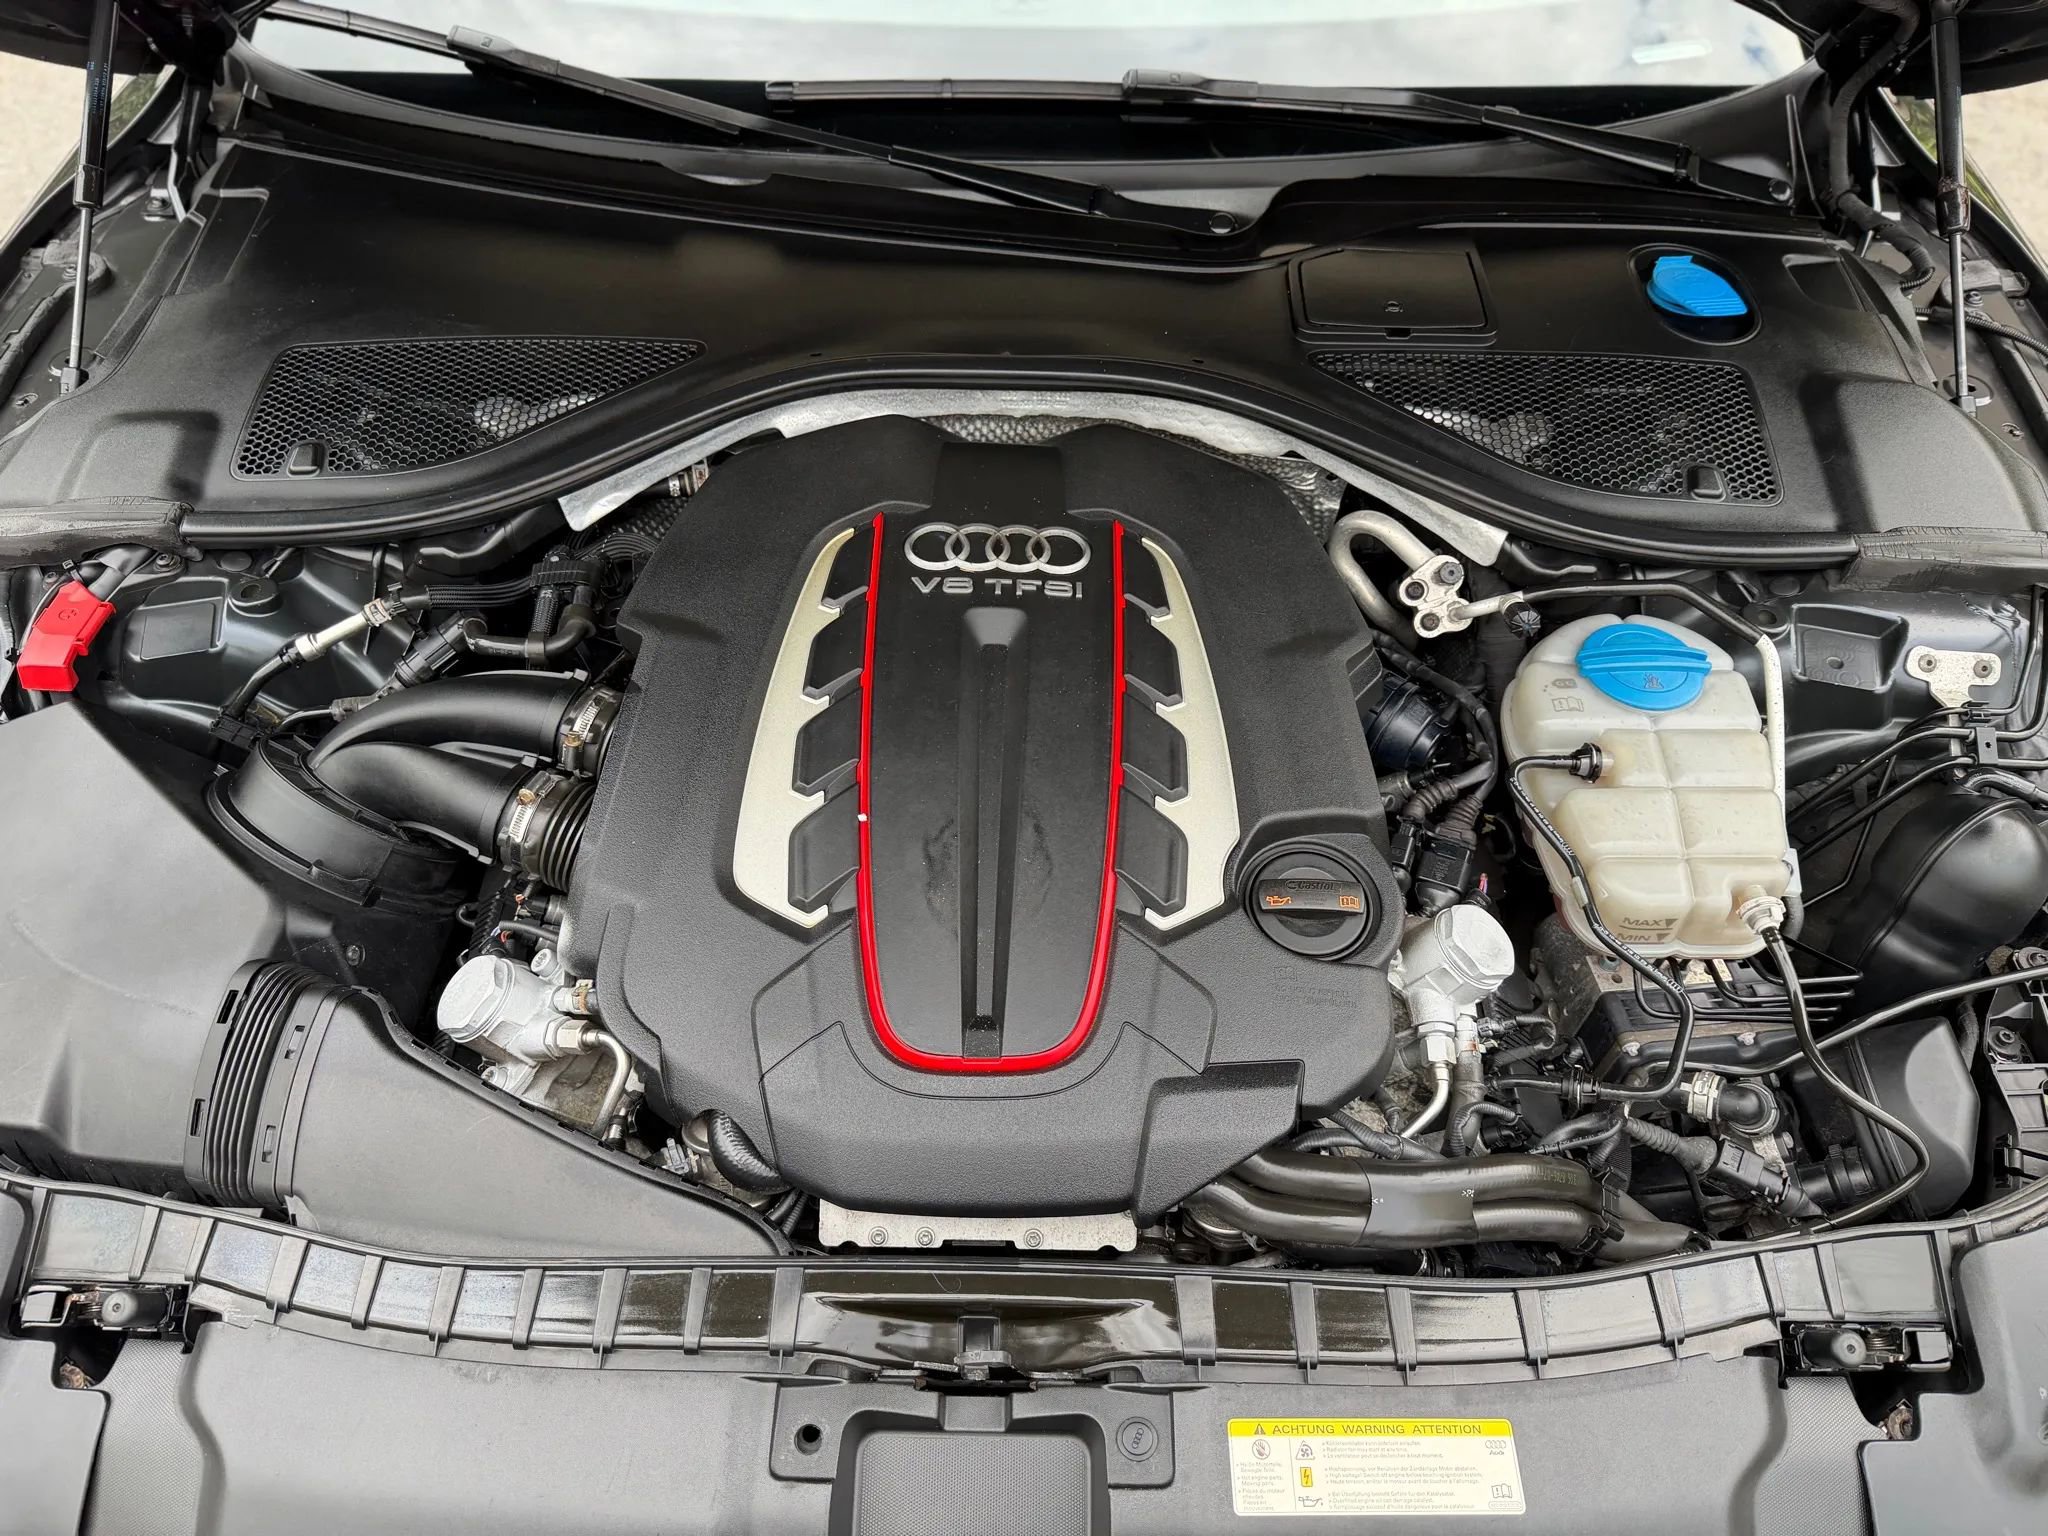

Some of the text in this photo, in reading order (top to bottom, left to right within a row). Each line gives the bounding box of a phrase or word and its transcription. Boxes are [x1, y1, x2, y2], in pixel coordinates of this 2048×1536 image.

[911, 576, 1083, 598] V8 TFSI
[1298, 880, 1334, 890] Castrol
[1622, 917, 1663, 927] MAX
[1617, 932, 1651, 941] MIN
[1272, 1424, 1482, 1435] ACHTUNG WARNING ATTENTION
